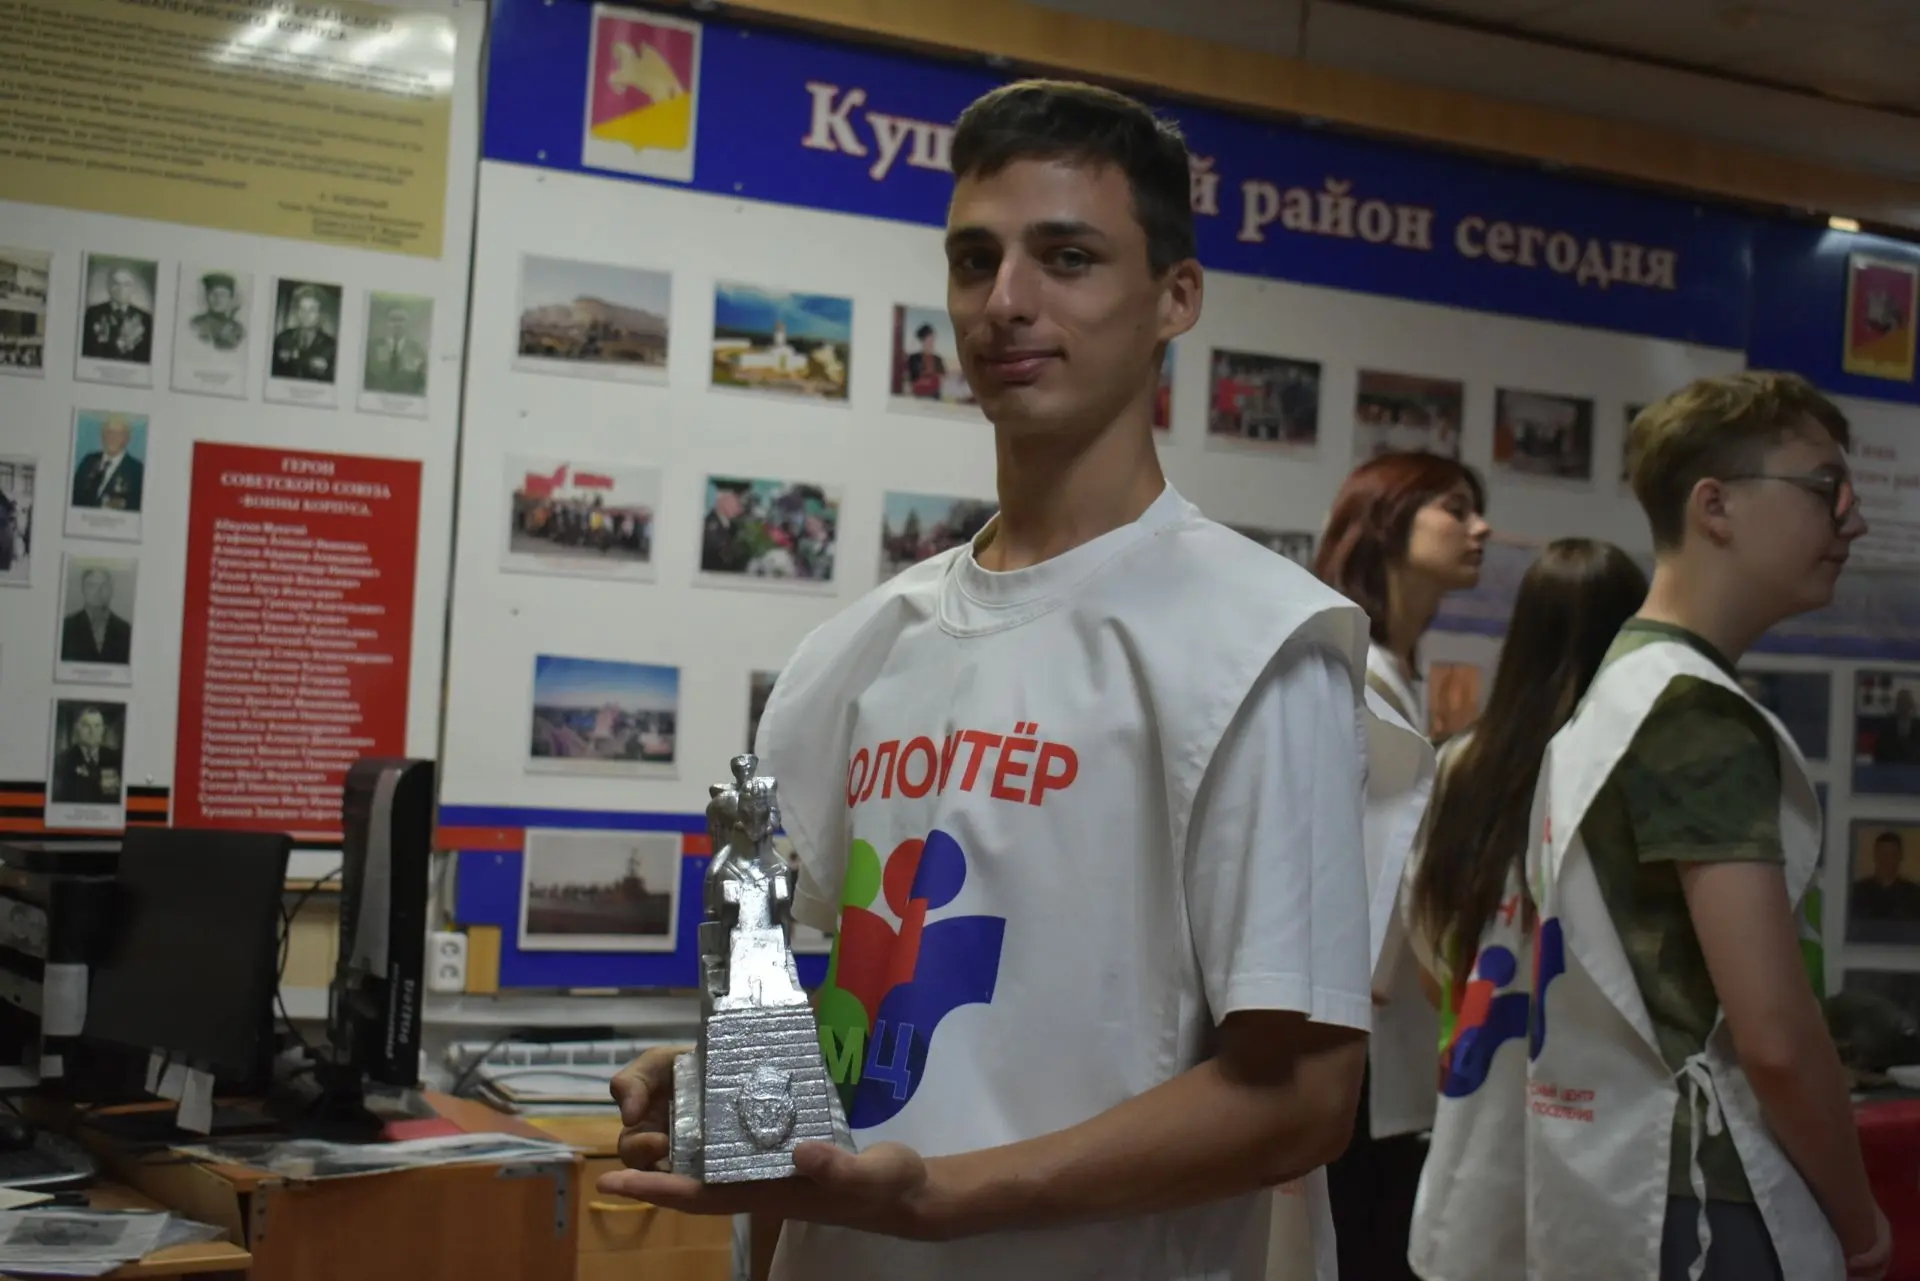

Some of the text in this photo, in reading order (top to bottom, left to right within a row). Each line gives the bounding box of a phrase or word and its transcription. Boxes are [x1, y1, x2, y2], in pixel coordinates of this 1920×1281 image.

[1237, 178, 1434, 250] район
[1454, 215, 1679, 290] сегодня
[220, 472, 330, 495] СОВЕТСКОГО
[847, 721, 1080, 808] ОЛОТЁР
